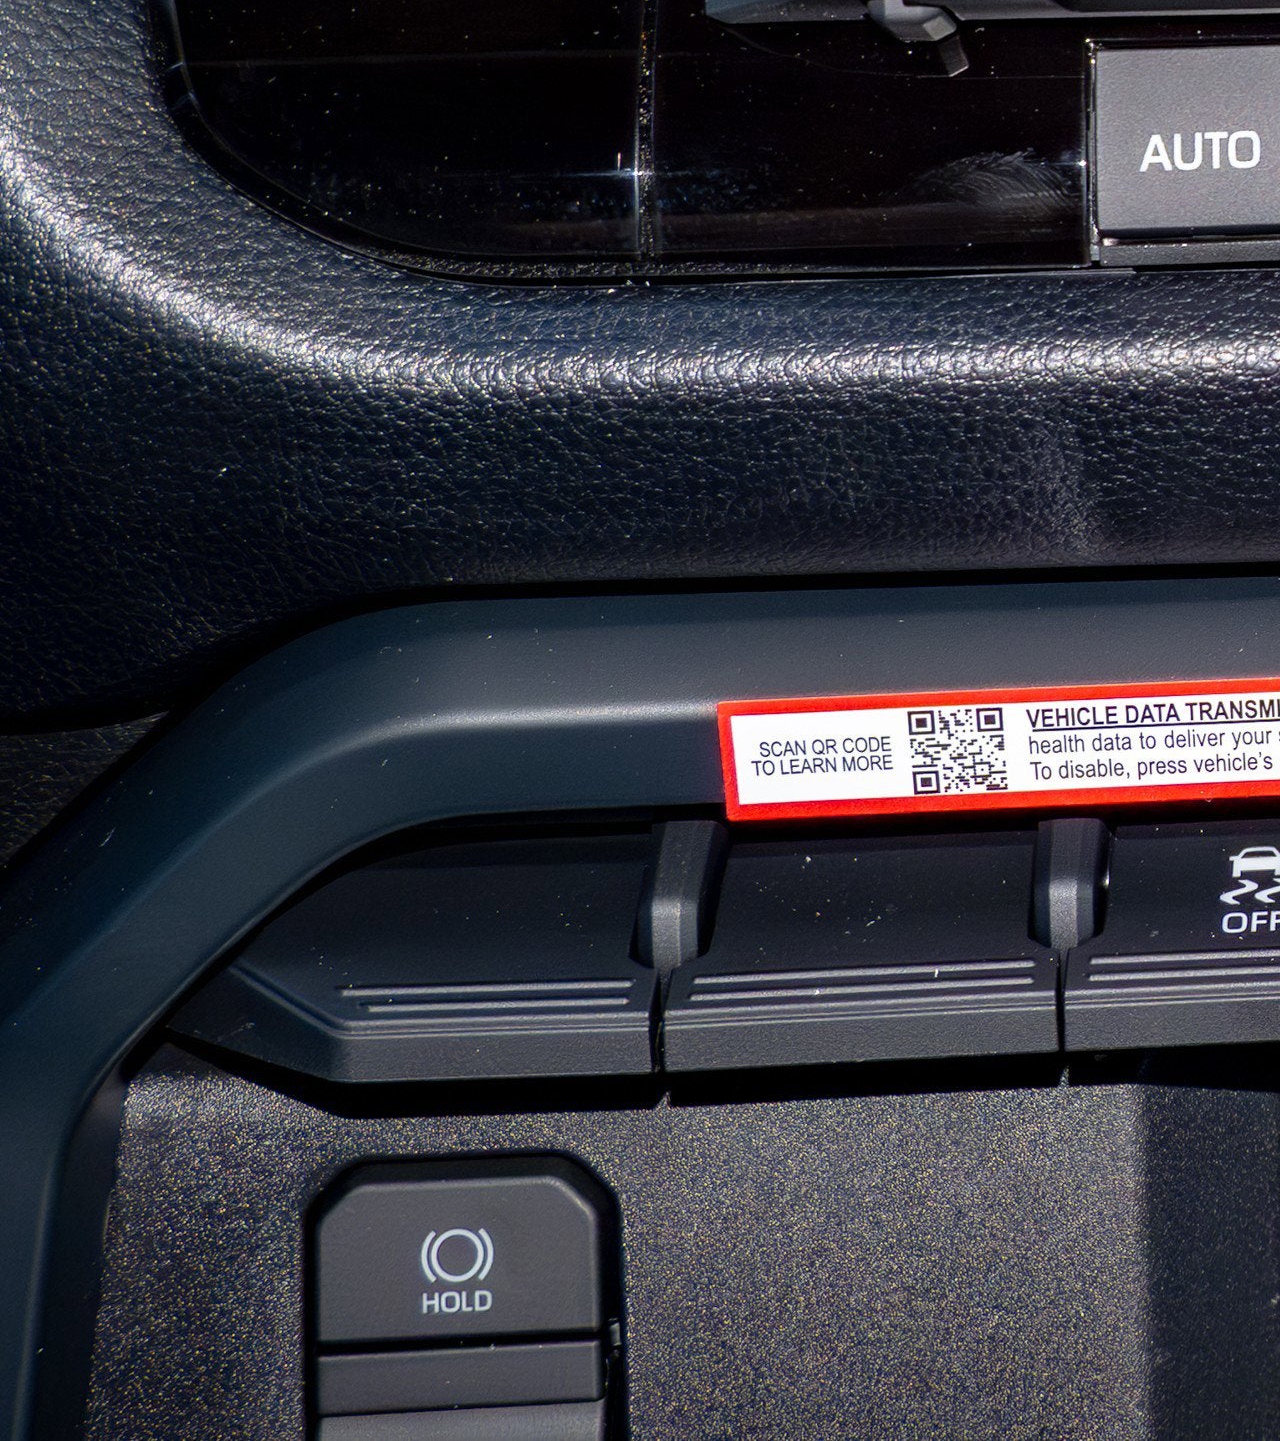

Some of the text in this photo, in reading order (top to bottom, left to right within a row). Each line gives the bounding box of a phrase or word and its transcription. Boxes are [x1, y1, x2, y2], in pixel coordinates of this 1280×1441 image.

[1138, 129, 1262, 172] AUTO
[1026, 707, 1119, 728] VEHICLE
[1126, 704, 1180, 724] DATA
[759, 736, 892, 757] SCAN QR CODE
[1029, 734, 1086, 754] health
[1092, 732, 1132, 752] data
[1139, 731, 1157, 749] to
[1164, 727, 1226, 747] deliver
[1231, 726, 1271, 749] your
[751, 755, 893, 776] TO LEARN MORE
[1030, 761, 1052, 780] To
[1058, 757, 1131, 780] disable,
[1138, 759, 1188, 779] press
[421, 1290, 493, 1315] HOLD
